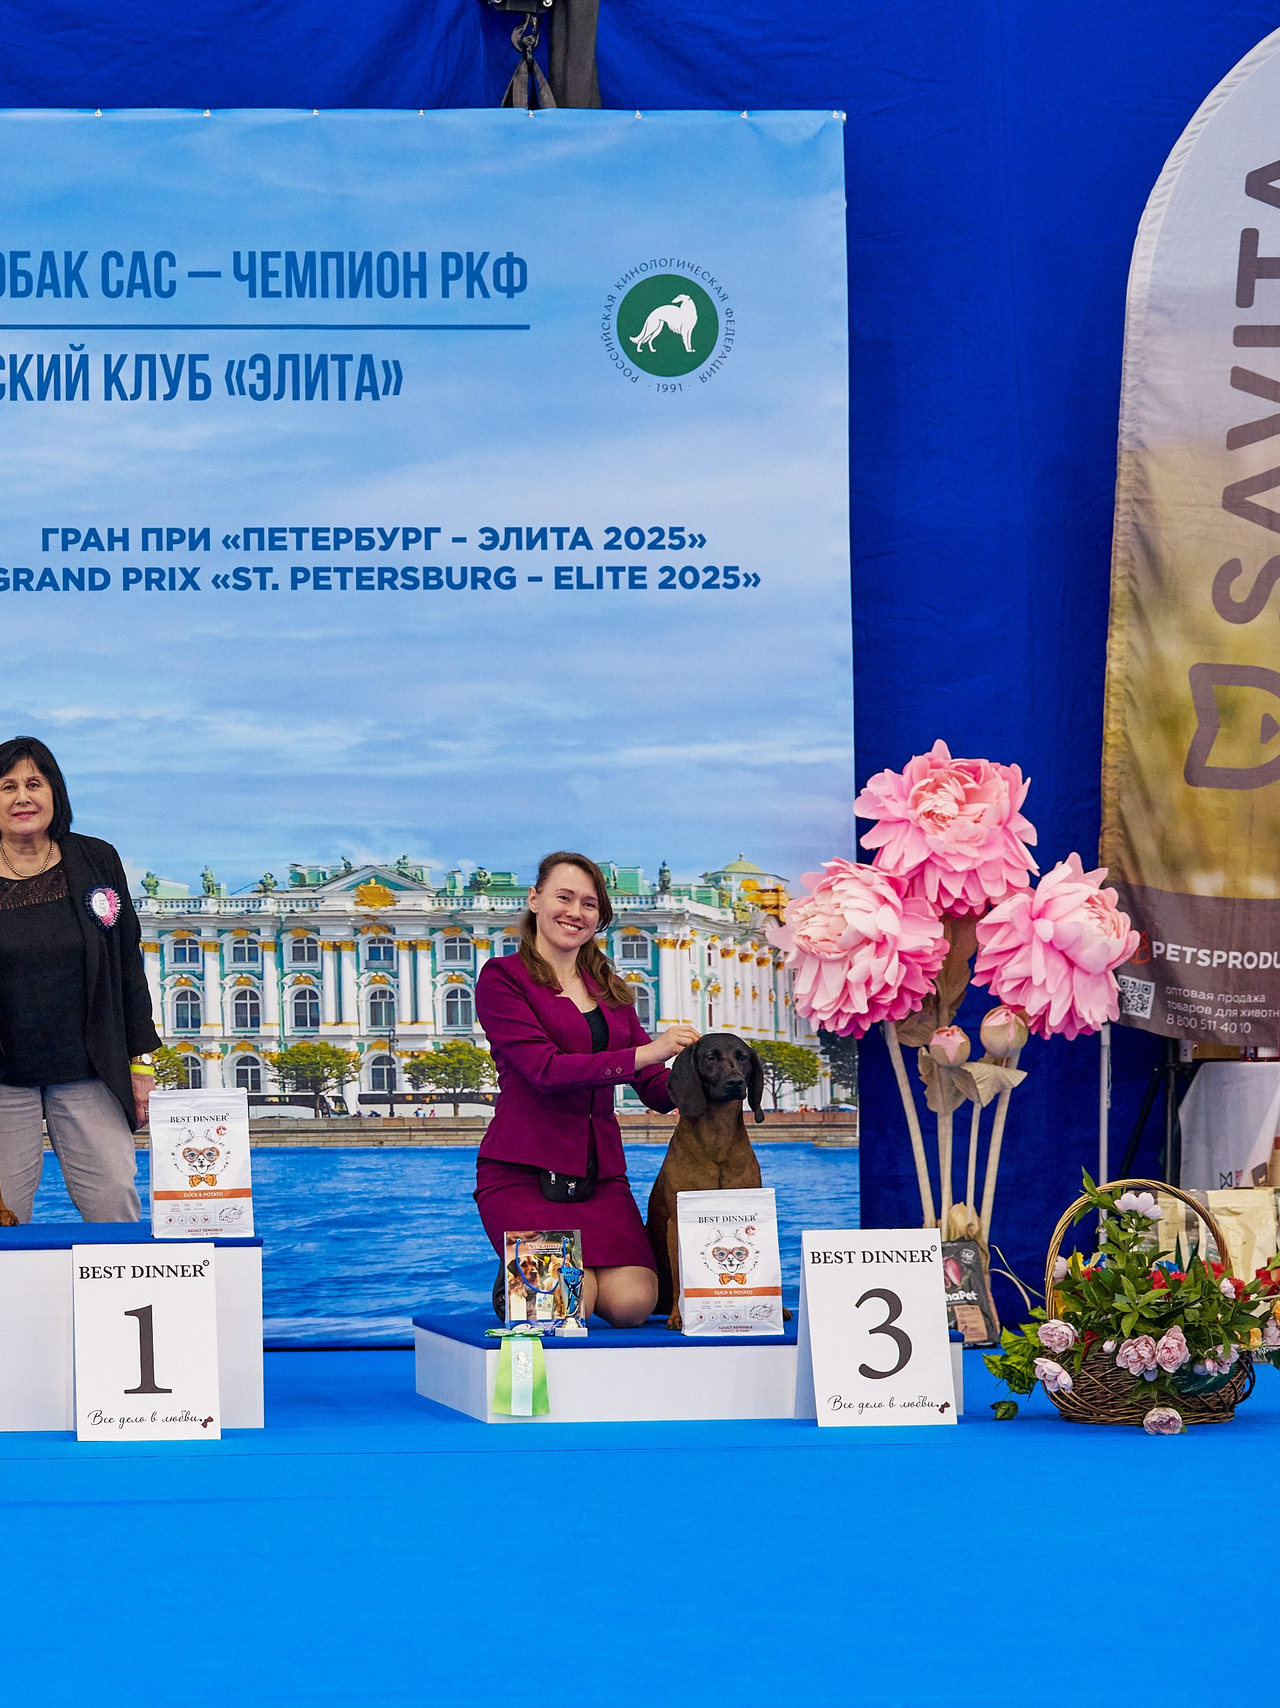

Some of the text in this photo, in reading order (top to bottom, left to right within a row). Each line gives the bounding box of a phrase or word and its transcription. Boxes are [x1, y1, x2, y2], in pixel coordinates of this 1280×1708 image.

[233, 251, 427, 298] ЧЕМПИОН
[441, 252, 527, 299] РКФ
[601, 257, 736, 384] РОССИЙСКАЯ КИНОЛОГИЧЕСКАЯ ФЕДЕРАЦИЯ
[104, 354, 211, 401] КЛУБ
[225, 353, 403, 401] «ЭЛИТА»
[655, 382, 684, 393] 1991
[42, 528, 129, 552] ГРАН
[142, 527, 210, 551] ПРИ
[222, 527, 441, 551] «ПЕТЕРБУРГ
[478, 527, 593, 551] ЭЛИТА
[604, 526, 706, 551] 2025»
[123, 567, 201, 592] PRIX
[212, 567, 279, 591] «ST.
[291, 566, 516, 591] PETERSBURG
[555, 566, 647, 590] ELITE
[658, 566, 760, 590] 2025»
[1165, 985, 1266, 1004] оптовая продажа
[1167, 1000, 1212, 1015] товаров
[1214, 1008, 1238, 1018] для
[1166, 1013, 1174, 1025] 8
[1176, 1014, 1197, 1029] 800
[1201, 1019, 1217, 1031] 511
[810, 1250, 856, 1265] BEST
[79, 1265, 125, 1279] BEST
[855, 1288, 913, 1380] 3
[124, 1304, 172, 1394] 1
[827, 1394, 854, 1411] Все
[858, 1400, 885, 1415] дело
[888, 1396, 896, 1407] в
[87, 1409, 115, 1426] Все
[119, 1414, 147, 1429] дело
[150, 1411, 159, 1422] в
